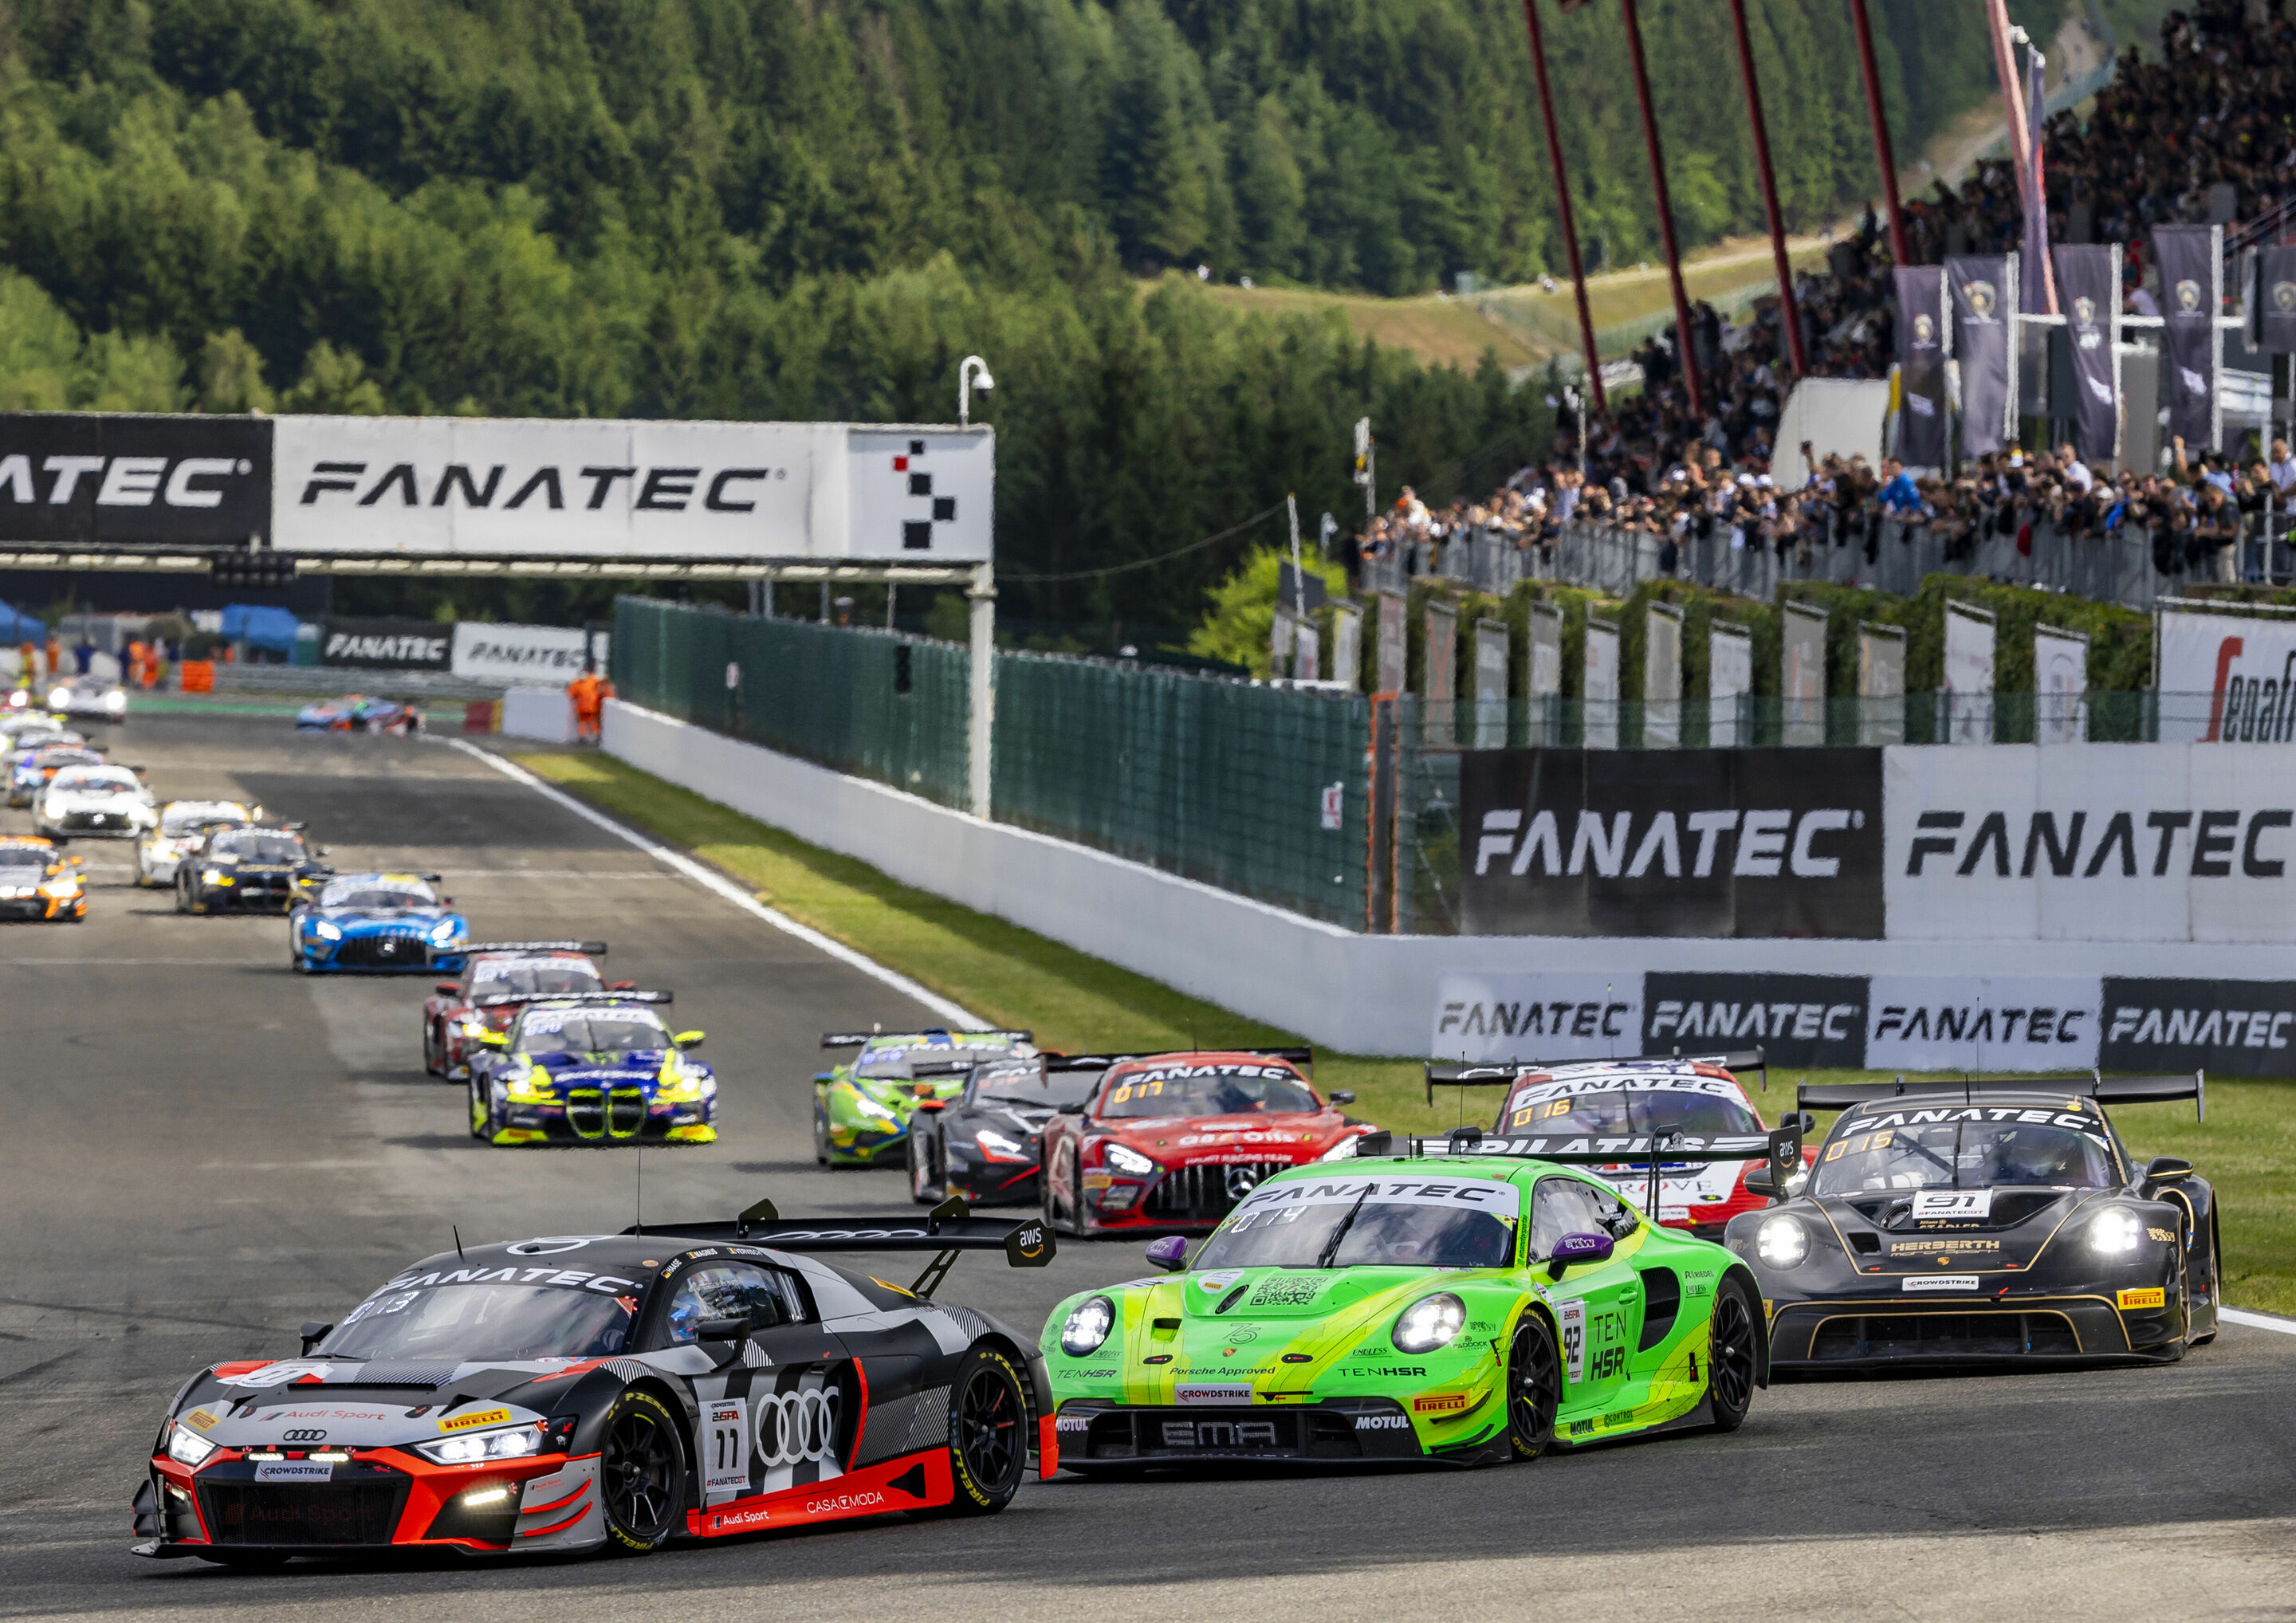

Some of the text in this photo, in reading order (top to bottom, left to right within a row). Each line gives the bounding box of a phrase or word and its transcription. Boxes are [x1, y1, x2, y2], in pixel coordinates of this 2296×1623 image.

[300, 462, 769, 513] FANATEC
[325, 633, 446, 662] FANATEC
[1475, 808, 1852, 878] FANATEC
[1906, 808, 2294, 878] FANATEC
[1438, 1000, 1629, 1039] FANATEC
[1649, 1000, 1854, 1041] FANATEC
[1874, 1006, 2087, 1043] FANATEC
[2108, 1006, 2293, 1049] FANATEC
[1122, 1065, 1287, 1087] FANATEC
[1521, 1078, 1724, 1105] FANATEC
[1841, 1108, 2090, 1138] FANATEC
[1779, 1141, 1794, 1157] aws
[1241, 1182, 1497, 1210] FANATEC
[1923, 1196, 1976, 1208] 91
[1020, 1227, 1042, 1248] aws
[1890, 1240, 2000, 1252] HERBERTH
[666, 1258, 682, 1275] HAASE
[375, 1267, 635, 1296] FANATEC
[2122, 1291, 2161, 1306] PIRELLI
[1594, 1310, 1626, 1344] TEN
[1353, 1347, 1389, 1356] ENDLESS
[1453, 1340, 1488, 1350] PADDOCK
[1563, 1326, 1581, 1364] 92
[1170, 1366, 1276, 1377] Porsche Approved
[1337, 1367, 1428, 1377] TENHSR
[1590, 1346, 1626, 1381] HSR
[1181, 1389, 1250, 1398] CROWDSTRIKE
[1413, 1395, 1466, 1412] PIRELLI
[189, 1411, 217, 1429] PIRELLI
[285, 1409, 387, 1421] Audi Sport
[445, 1410, 504, 1429] PIRELLI
[1355, 1416, 1409, 1429] MOTUL
[1056, 1419, 1088, 1432] MOTUL
[1162, 1421, 1276, 1446] EMA
[1570, 1417, 1595, 1436] MOTUL
[716, 1428, 739, 1470] 11
[264, 1466, 330, 1476] CROWDSTRIKE
[953, 1448, 991, 1507] PIRELLI
[706, 1476, 746, 1487] #FANATECGT
[253, 1505, 301, 1522] Audi
[723, 1510, 771, 1526] Audi Sport
[611, 1525, 655, 1550] PIRELLI
